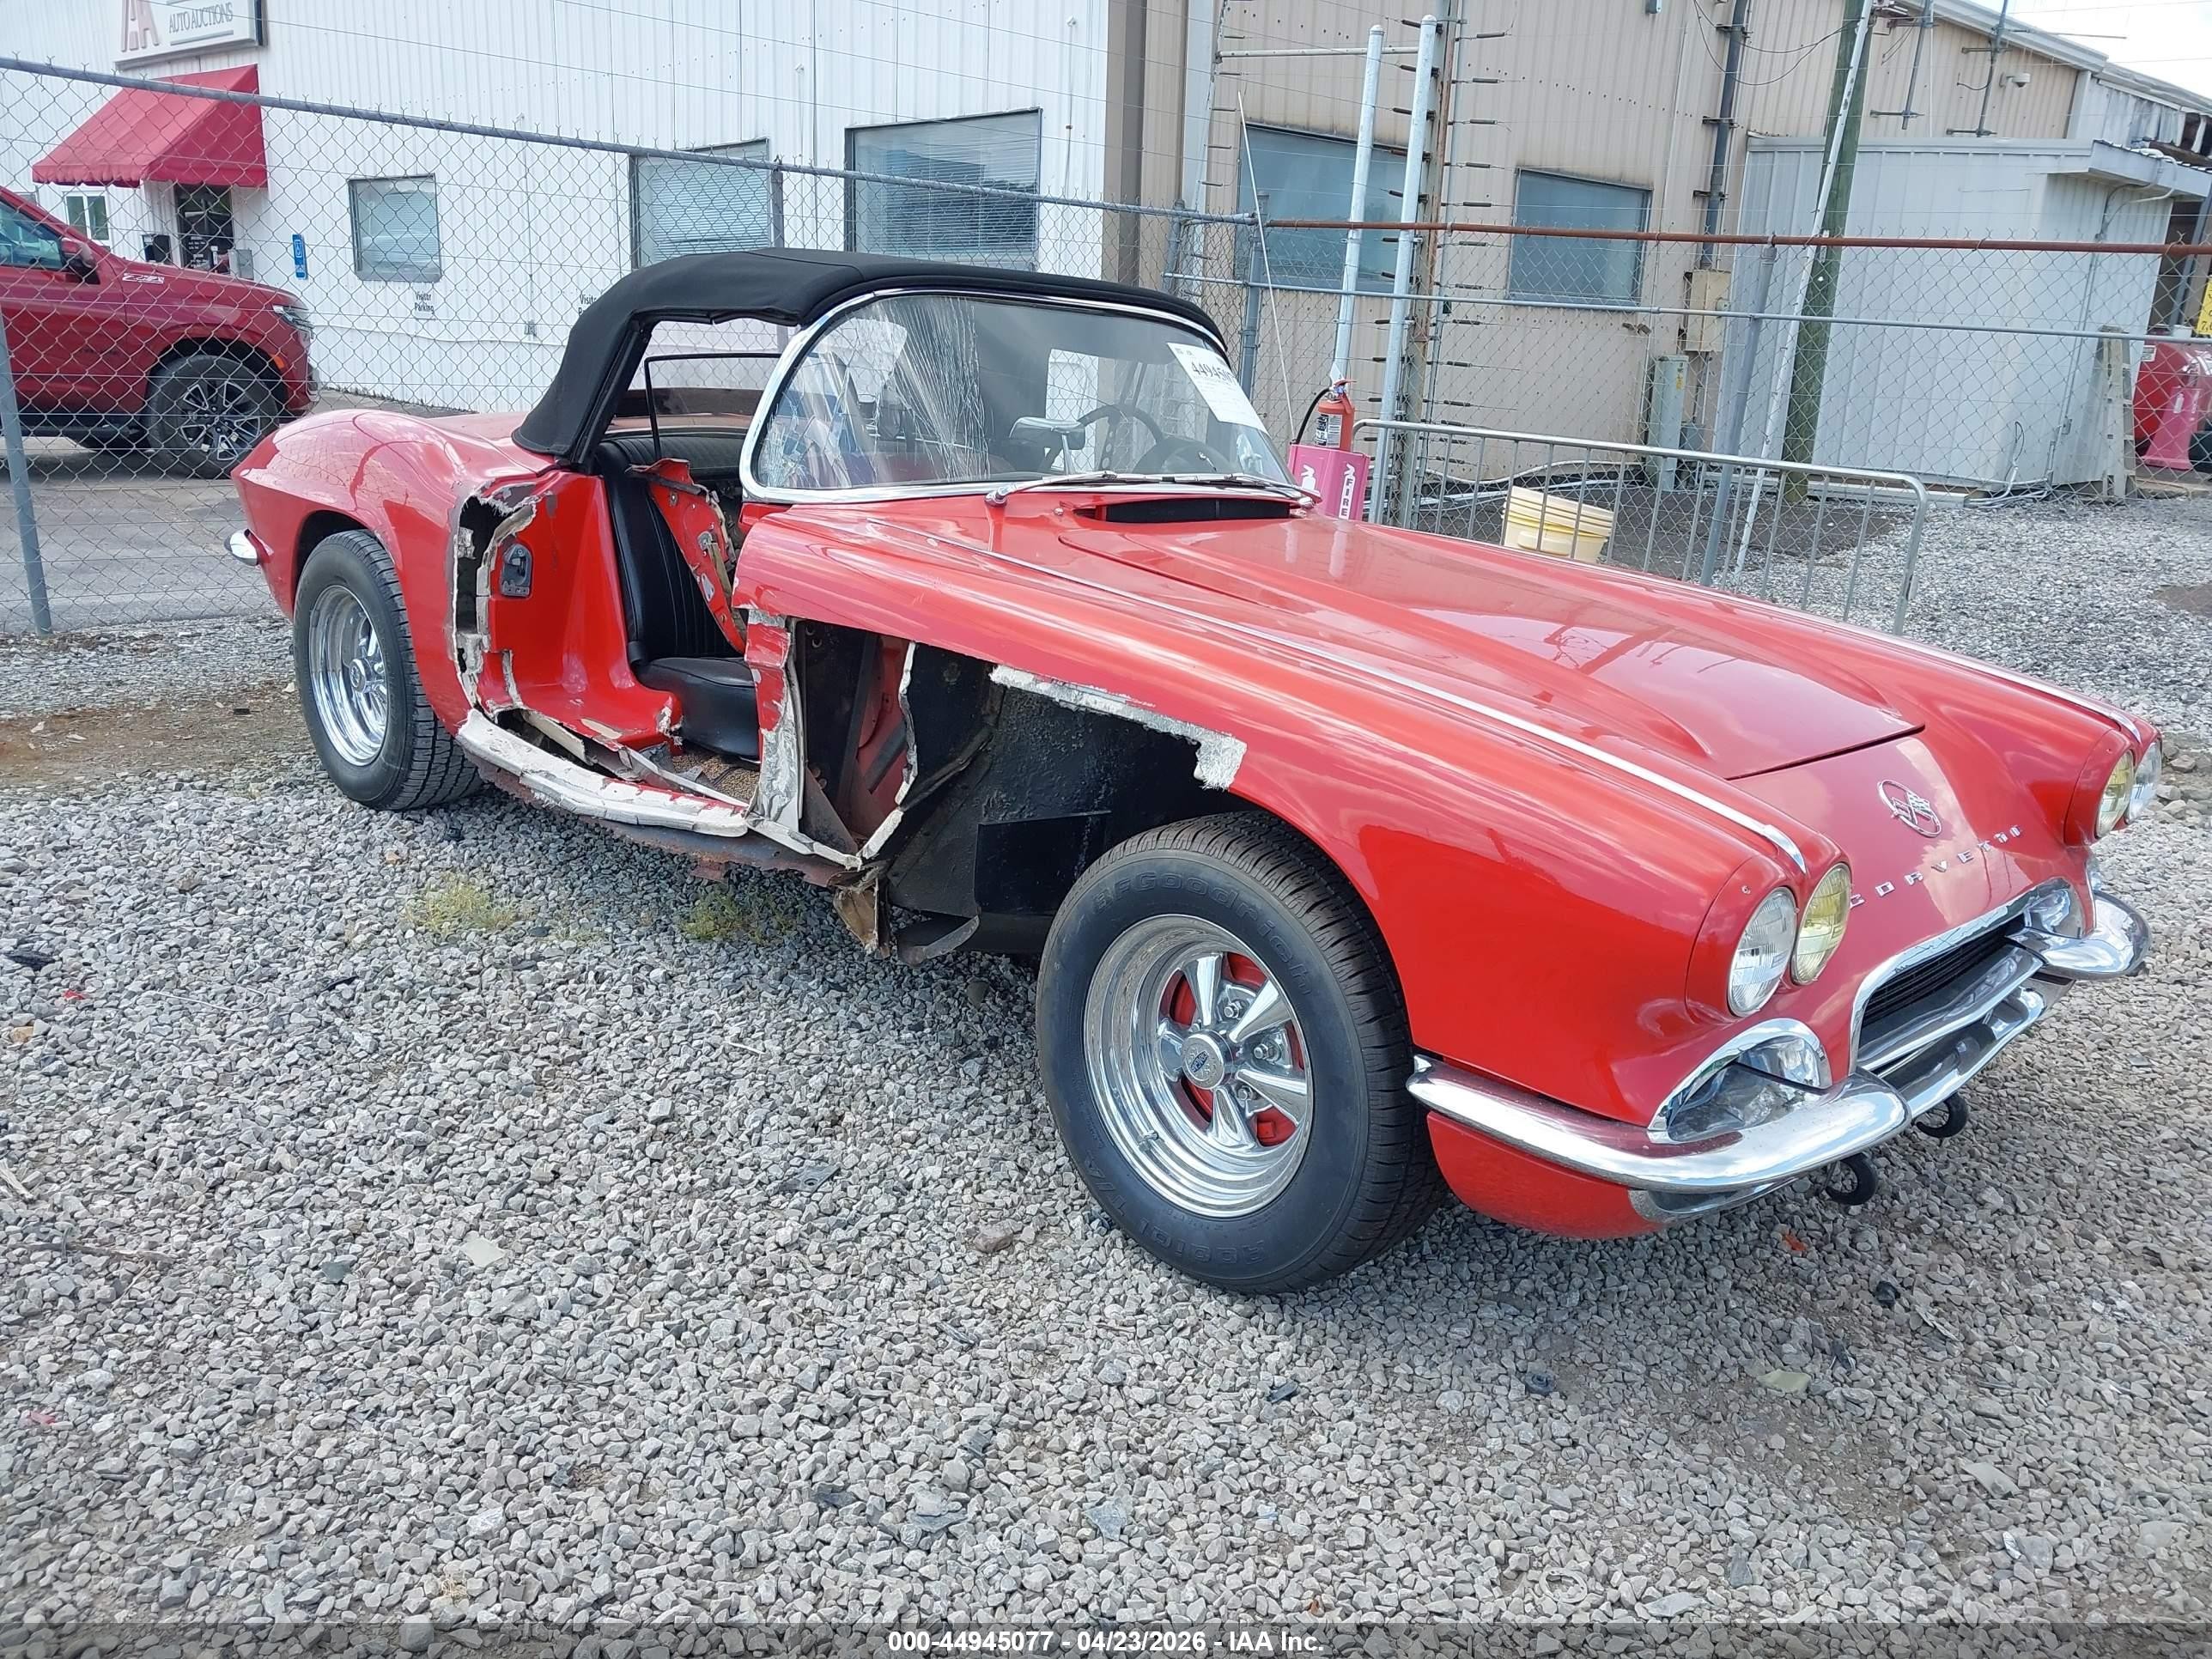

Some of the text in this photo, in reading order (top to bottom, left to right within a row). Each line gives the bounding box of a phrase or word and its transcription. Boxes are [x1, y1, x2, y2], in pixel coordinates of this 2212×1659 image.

[169, 2, 234, 33] AUTO AUCTIONS
[414, 302, 434, 315] Parking
[1340, 478, 1353, 516] FIRE
[1092, 871, 1312, 997] BFGoodrich
